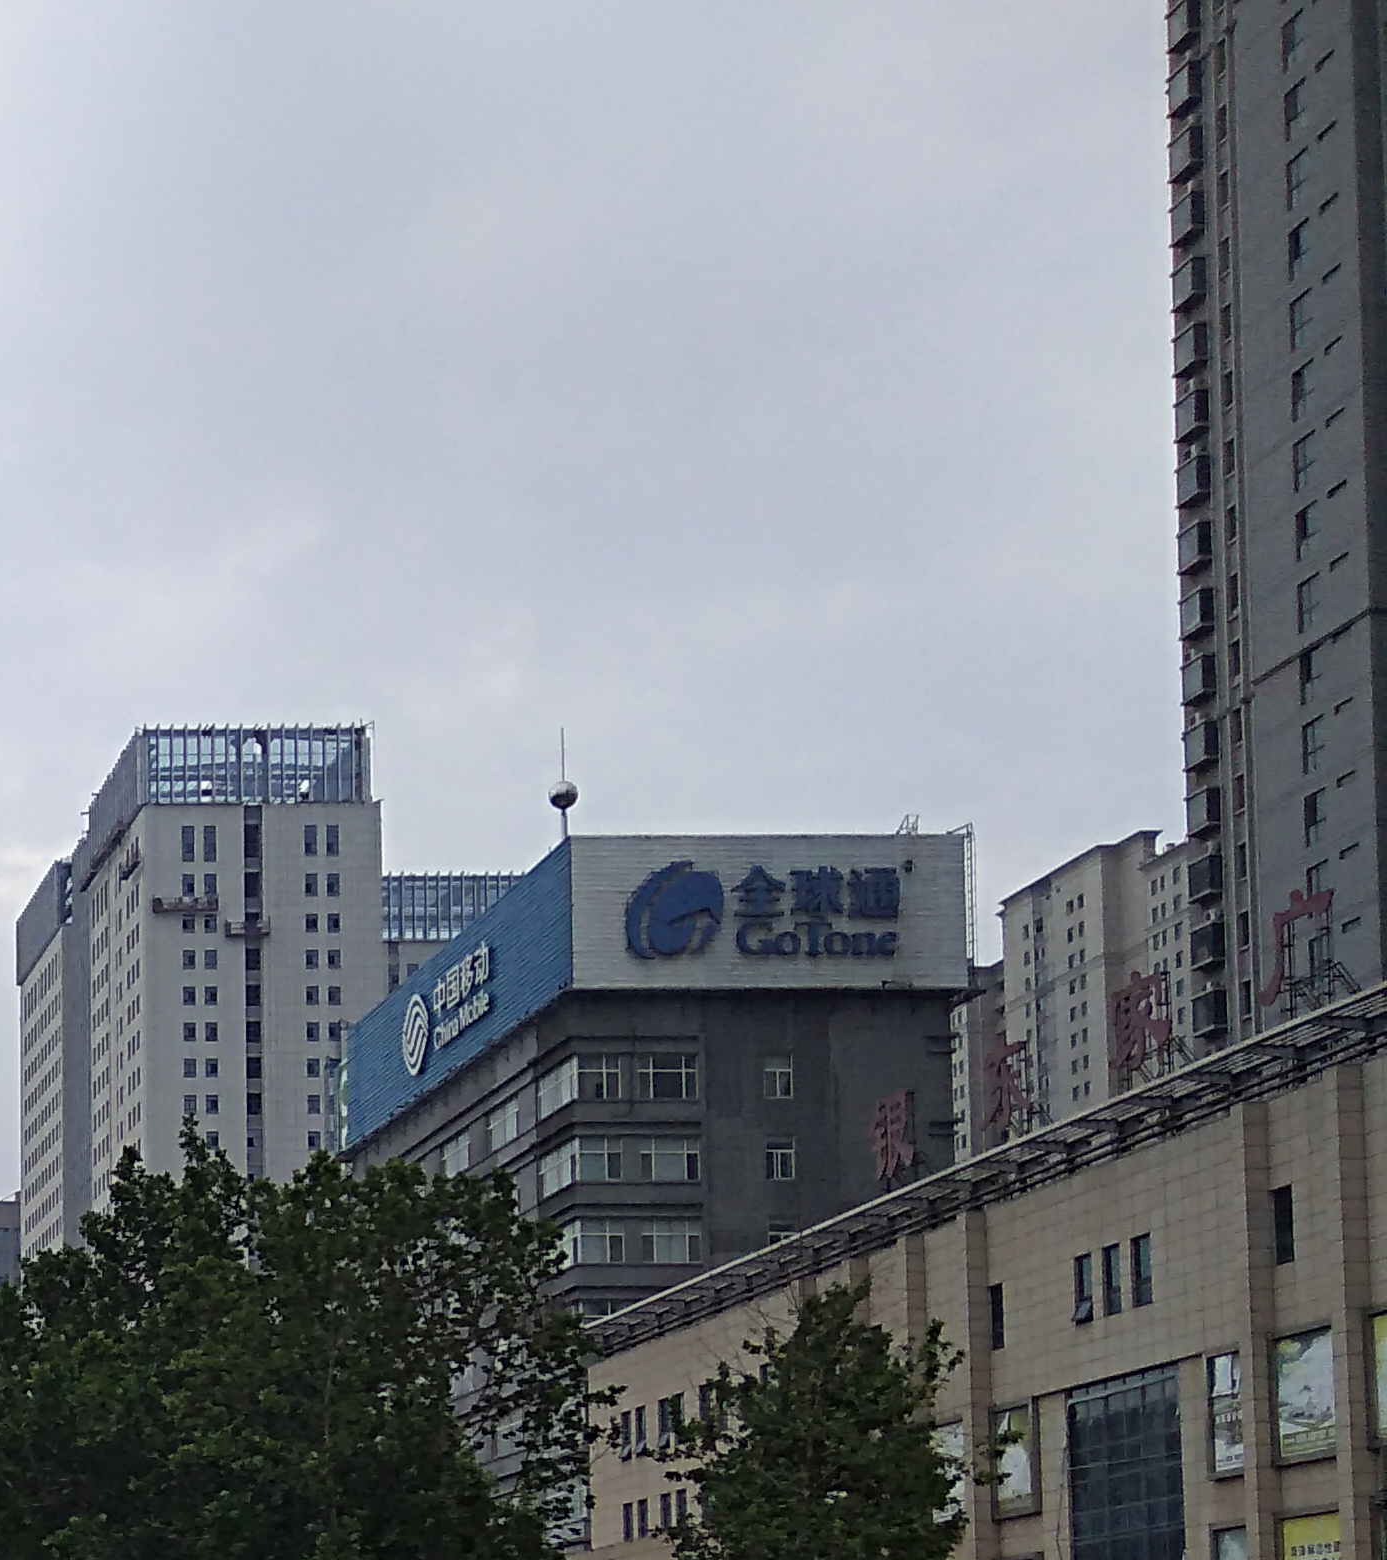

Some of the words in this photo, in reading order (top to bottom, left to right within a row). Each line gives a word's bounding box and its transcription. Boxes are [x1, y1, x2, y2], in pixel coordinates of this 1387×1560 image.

[731, 865, 901, 918] 全球通
[736, 921, 898, 957] GoTone
[433, 941, 489, 1017] 中国移动
[434, 1015, 460, 1050] China
[459, 989, 490, 1031] Mobile
